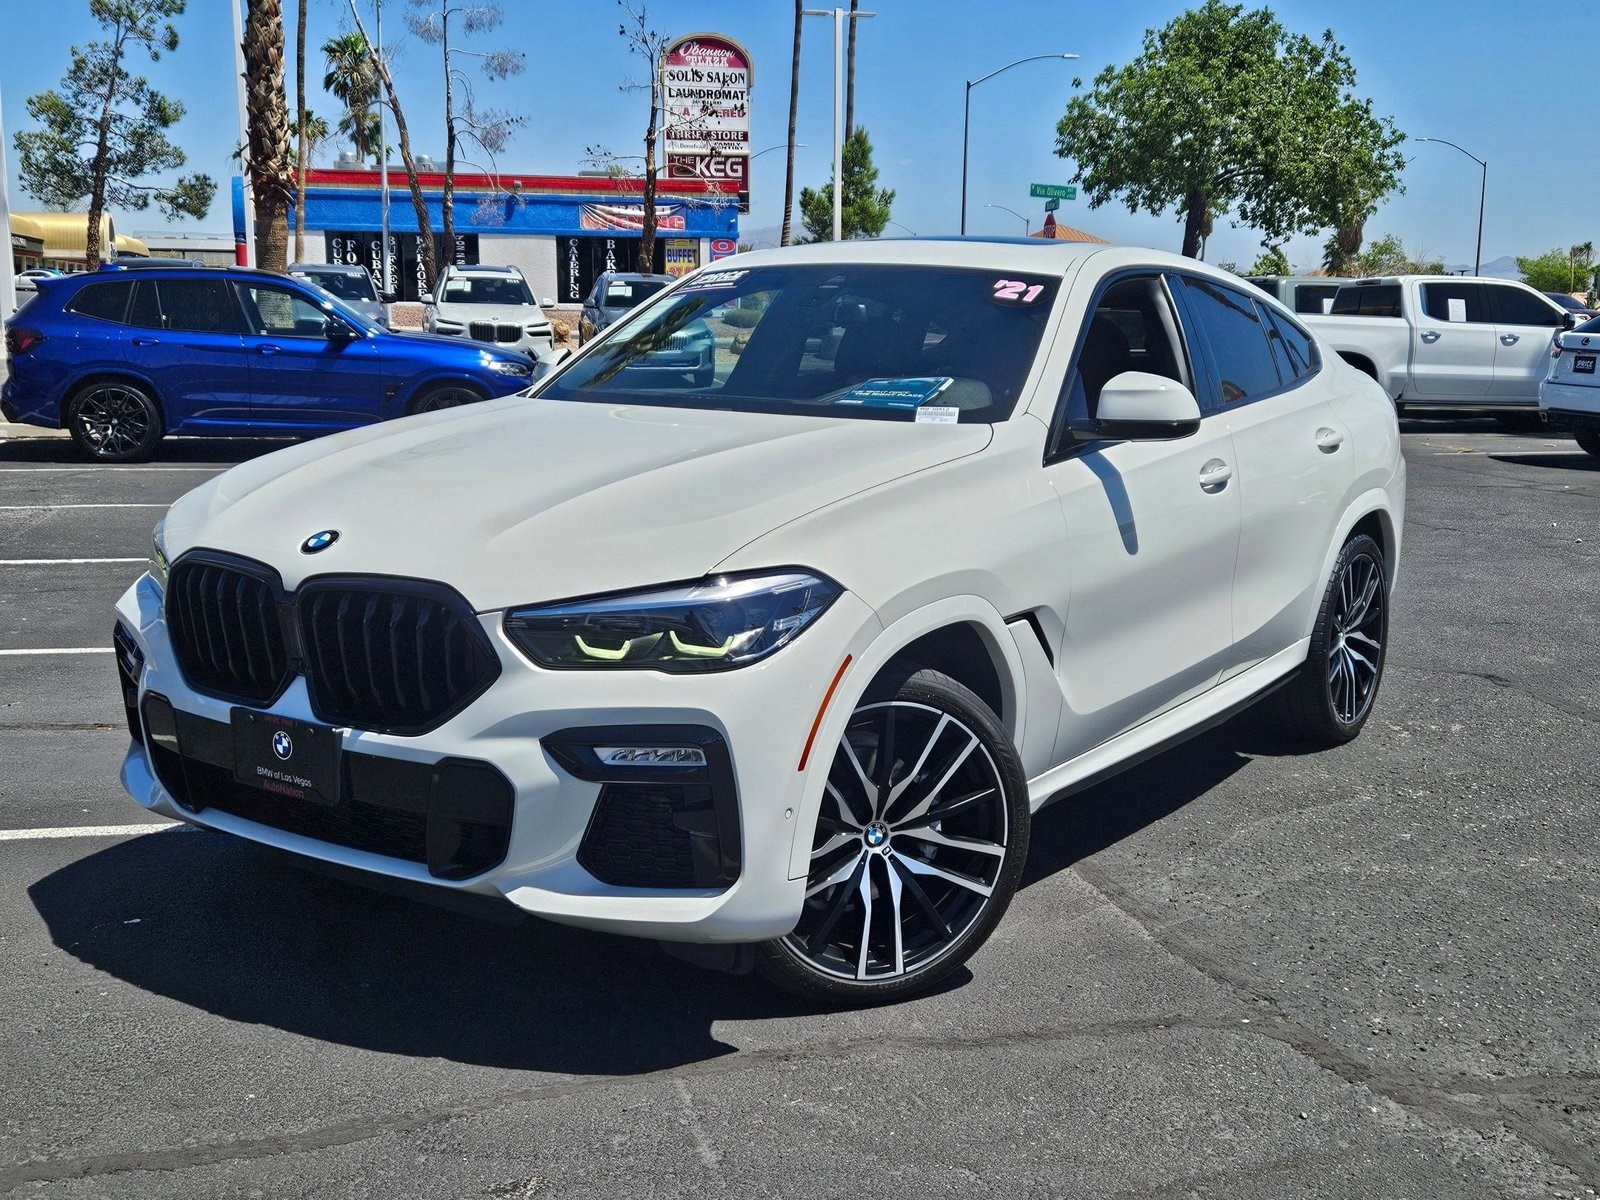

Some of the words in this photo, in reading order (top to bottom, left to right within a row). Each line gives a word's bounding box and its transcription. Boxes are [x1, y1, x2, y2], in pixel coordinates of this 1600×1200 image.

[685, 55, 729, 67] PLAZA
[668, 69, 704, 83] SOLIS
[706, 71, 745, 85] SALON
[668, 87, 746, 101] LAUNDROMAT
[710, 131, 744, 140] STORE
[674, 155, 695, 164] THE
[695, 156, 743, 177] KEG
[371, 240, 383, 288] CUBAN
[667, 248, 698, 264] BUFFET
[569, 238, 580, 299] CATERING
[256, 766, 274, 778] BMW
[273, 771, 281, 779] of
